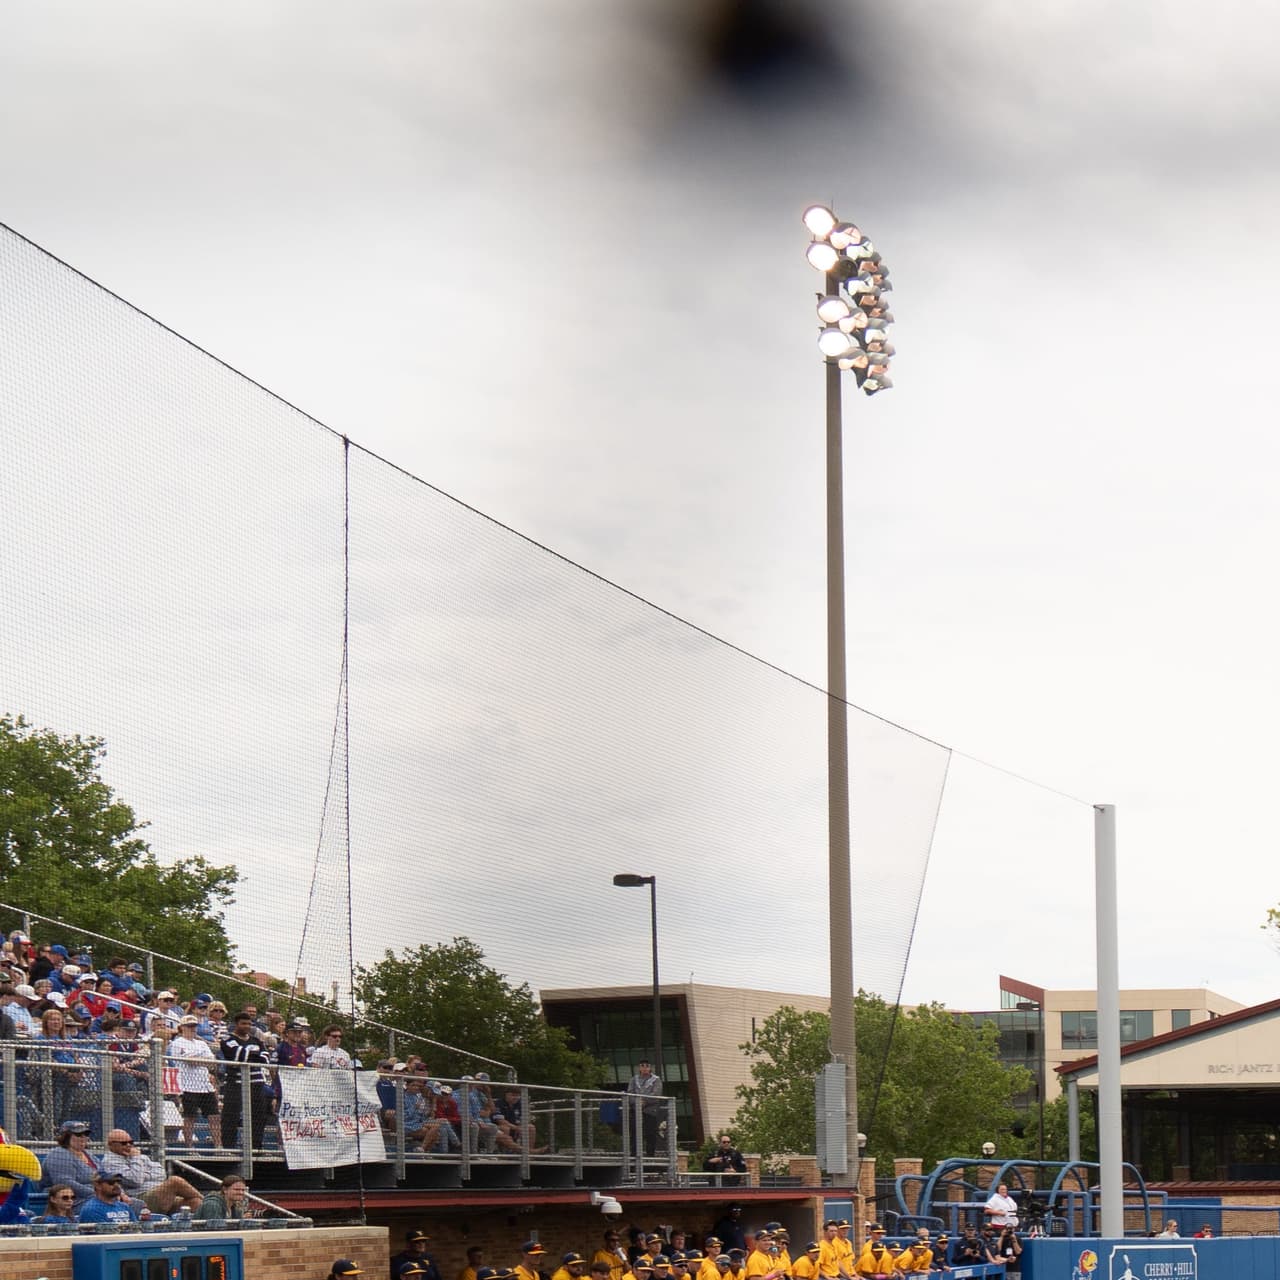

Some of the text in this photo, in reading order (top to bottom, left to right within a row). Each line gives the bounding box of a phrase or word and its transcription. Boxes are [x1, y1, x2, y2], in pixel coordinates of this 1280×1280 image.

[1208, 1064, 1233, 1074] RICH
[1237, 1064, 1273, 1075] JANTZ
[1144, 1262, 1194, 1277] CHERRY HILL
